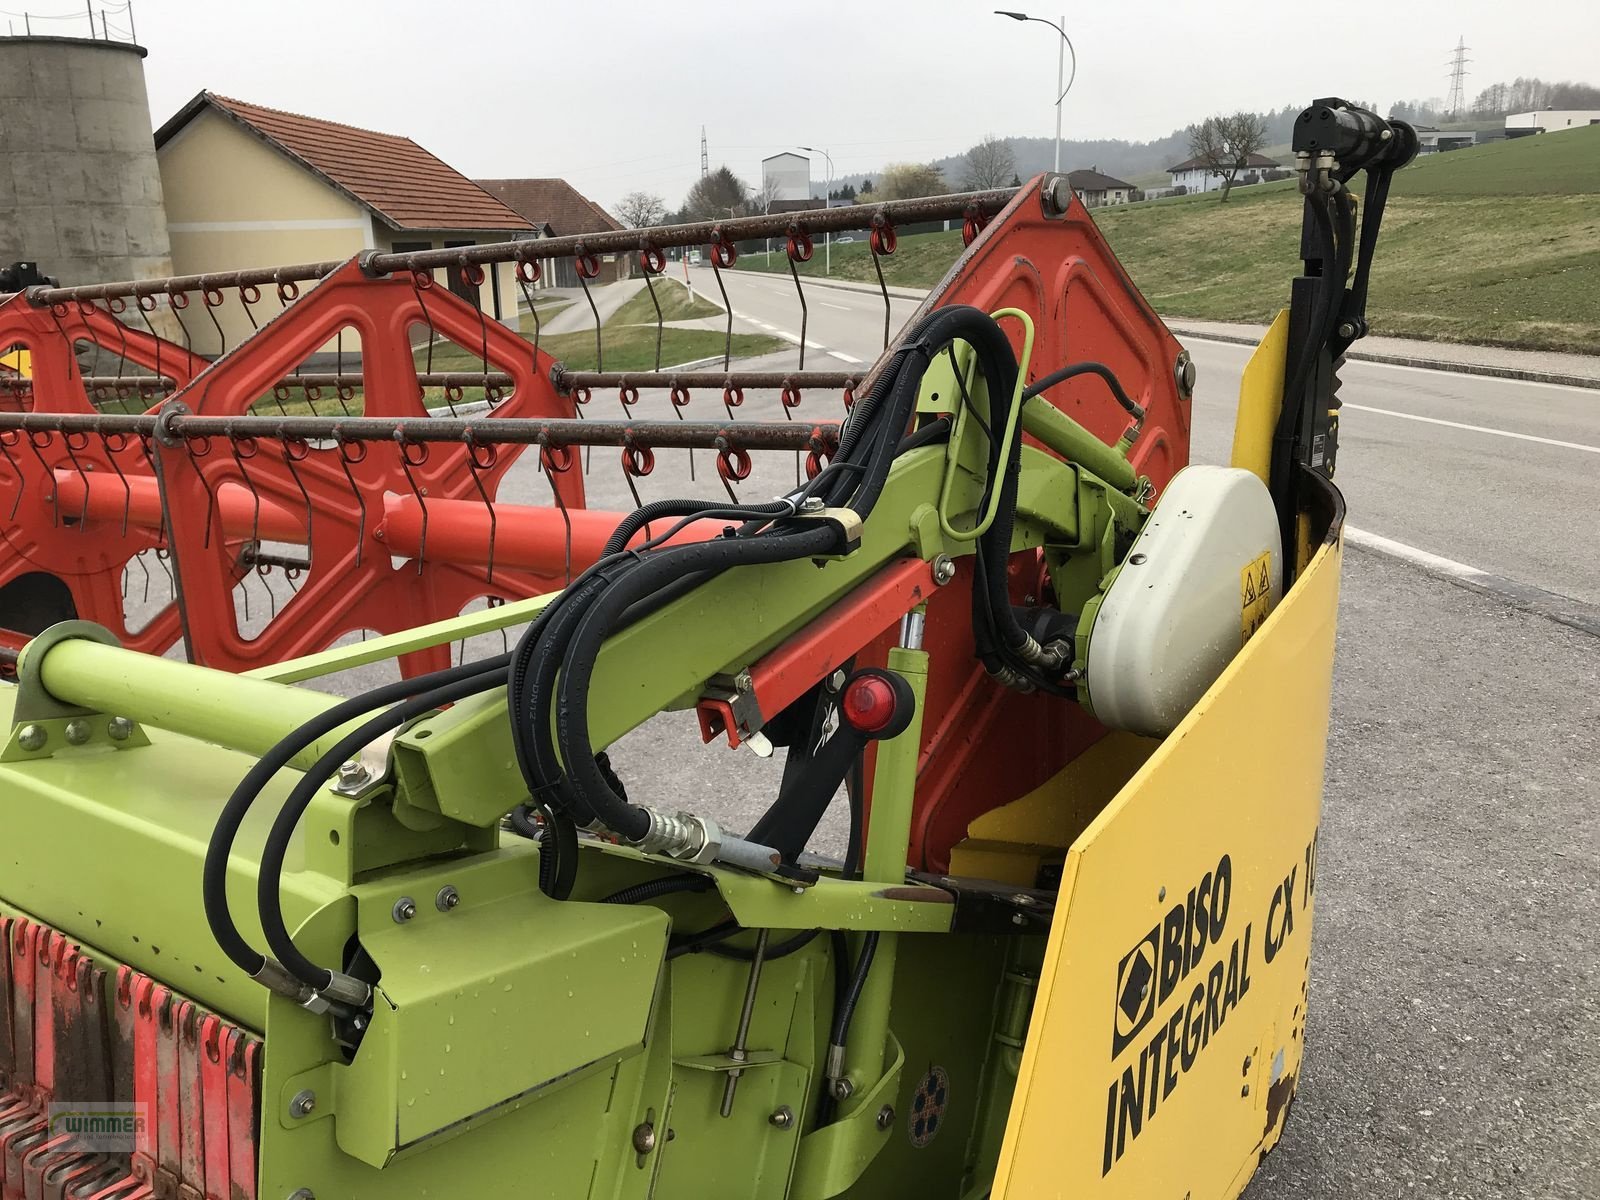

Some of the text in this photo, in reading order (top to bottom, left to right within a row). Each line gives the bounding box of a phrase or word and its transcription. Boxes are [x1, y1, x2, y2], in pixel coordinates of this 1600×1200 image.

[568, 586, 594, 613] EN857
[529, 684, 539, 720] DN12
[1158, 854, 1232, 1008] BISO
[1102, 922, 1252, 1178] INTEGRAL
[1264, 863, 1298, 964] CX
